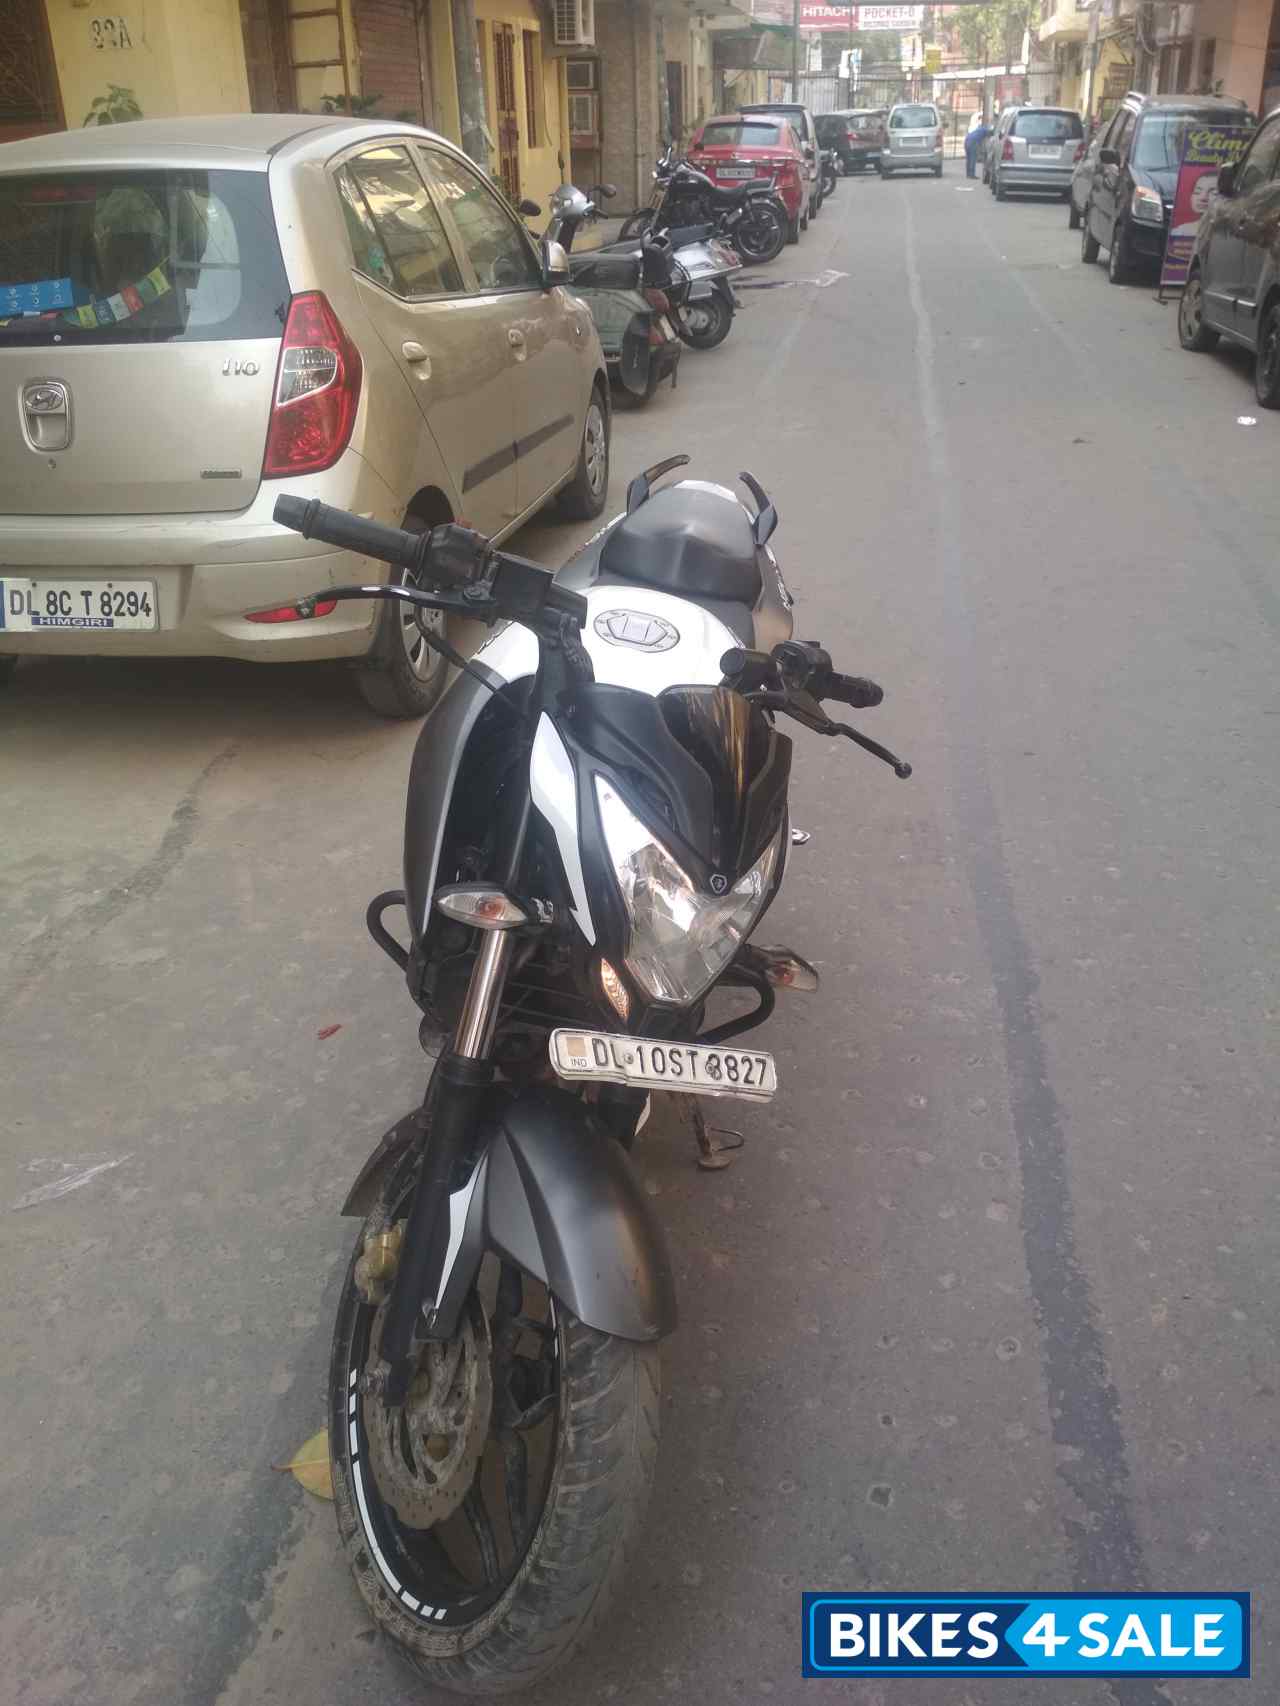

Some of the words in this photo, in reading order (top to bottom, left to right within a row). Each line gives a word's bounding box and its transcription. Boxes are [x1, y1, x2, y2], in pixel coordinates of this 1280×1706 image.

[802, 6, 855, 17] HITACHI
[9, 589, 40, 616] DL
[46, 590, 72, 616] 8C
[80, 590, 93, 616] T
[100, 591, 152, 617] 8294
[39, 617, 108, 627] HIMGIRI
[592, 1038, 623, 1069] DL
